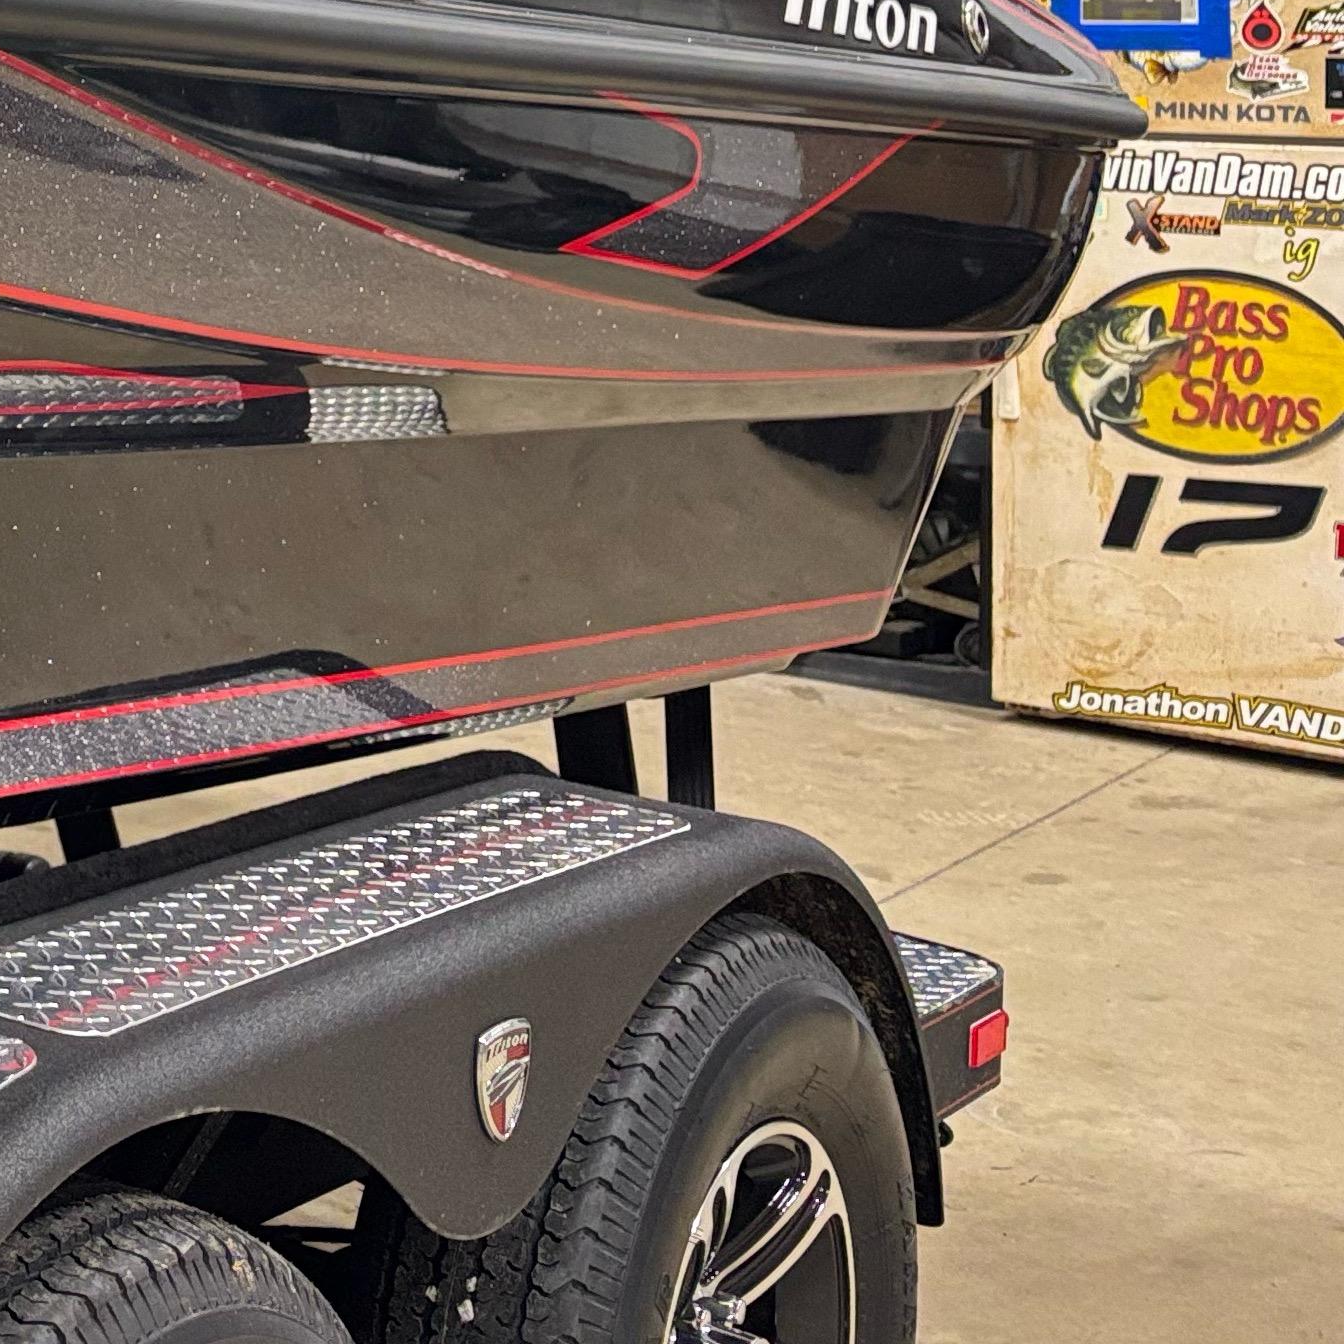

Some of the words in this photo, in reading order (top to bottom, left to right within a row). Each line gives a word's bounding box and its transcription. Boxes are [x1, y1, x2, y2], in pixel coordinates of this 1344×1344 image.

[1155, 101, 1229, 121] MINN
[1236, 103, 1312, 124] KOTA
[1169, 282, 1291, 341] Bass
[1171, 332, 1264, 385] Pro
[1172, 377, 1323, 447] Shops
[1057, 683, 1231, 724] Jonathon
